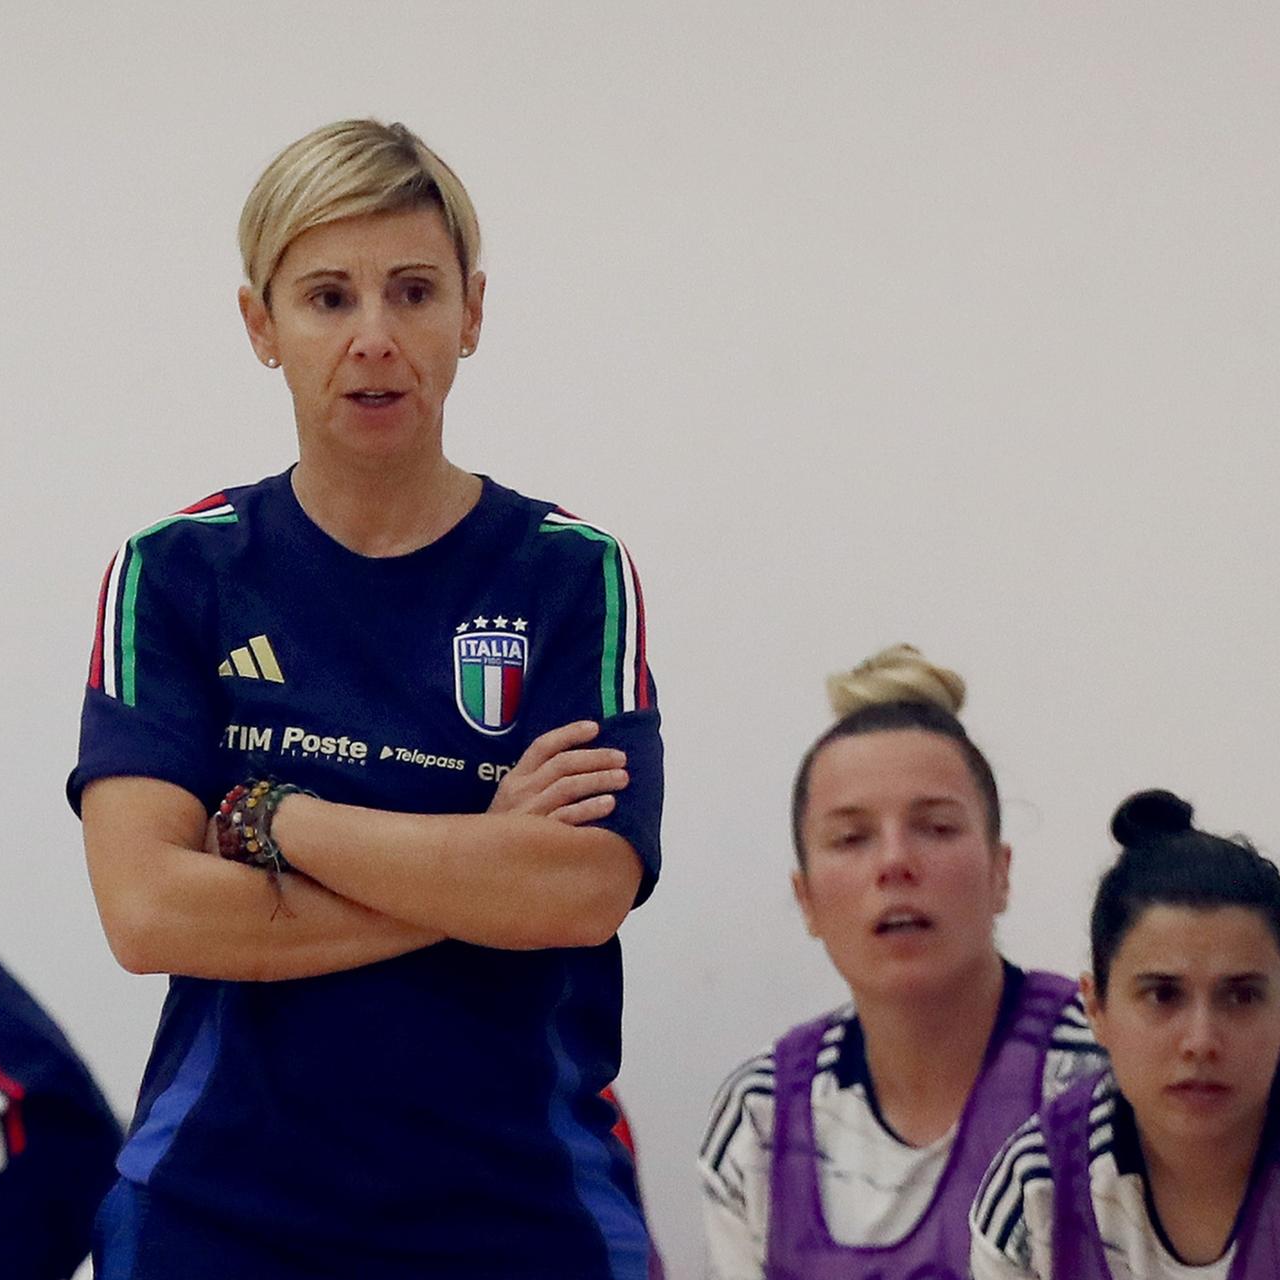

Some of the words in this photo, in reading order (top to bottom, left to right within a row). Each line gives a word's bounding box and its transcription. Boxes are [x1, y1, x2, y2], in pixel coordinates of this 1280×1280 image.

[461, 640, 523, 659] ITALIA
[227, 725, 273, 752] TIM
[282, 726, 368, 760] Poste
[395, 748, 465, 771] Telepass
[477, 762, 516, 783] en
